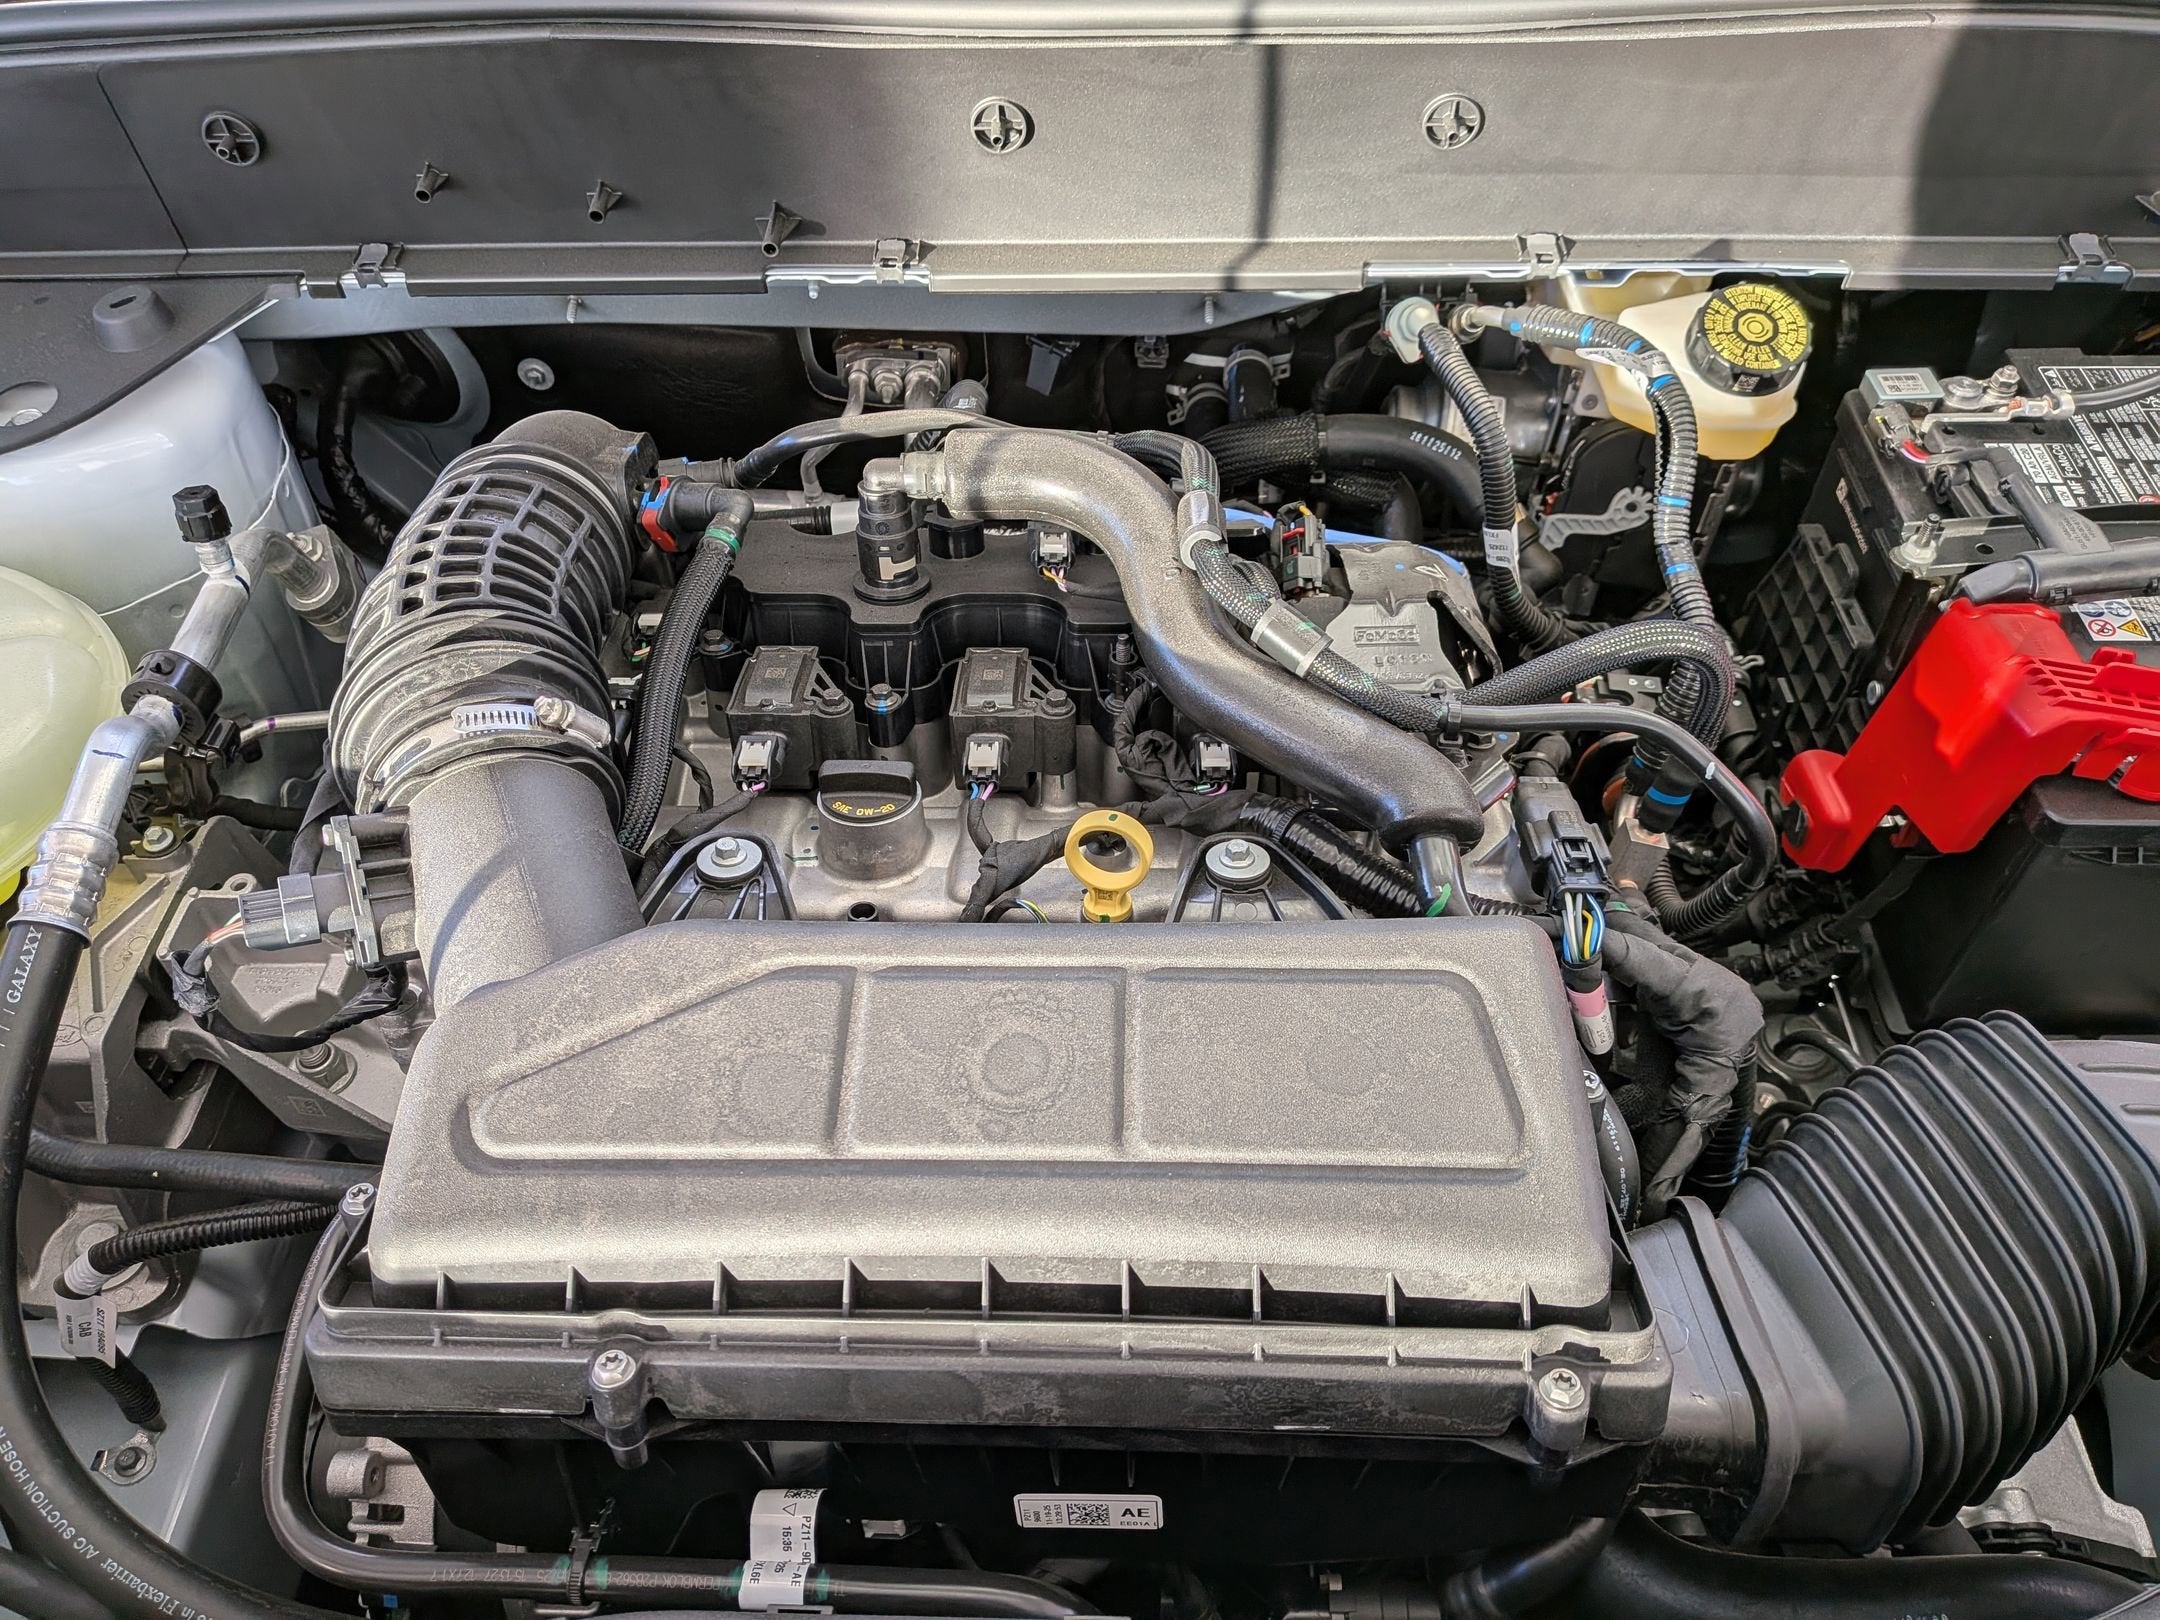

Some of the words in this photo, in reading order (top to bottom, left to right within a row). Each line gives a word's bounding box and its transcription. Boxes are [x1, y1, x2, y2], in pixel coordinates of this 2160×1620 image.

[2052, 444, 2078, 477] FoMoCo
[831, 801, 853, 814] SAE
[855, 803, 896, 816] 0W-20
[6, 925, 42, 1004] GALAXY
[78, 1321, 92, 1338] CAB
[0, 1440, 30, 1483] HOSE
[23, 1480, 76, 1541] SUCTION
[1121, 1508, 1150, 1518] AE
[73, 1537, 100, 1560] A/C
[782, 1526, 792, 1552] 15:35
[100, 1557, 181, 1617] Flexbarrier
